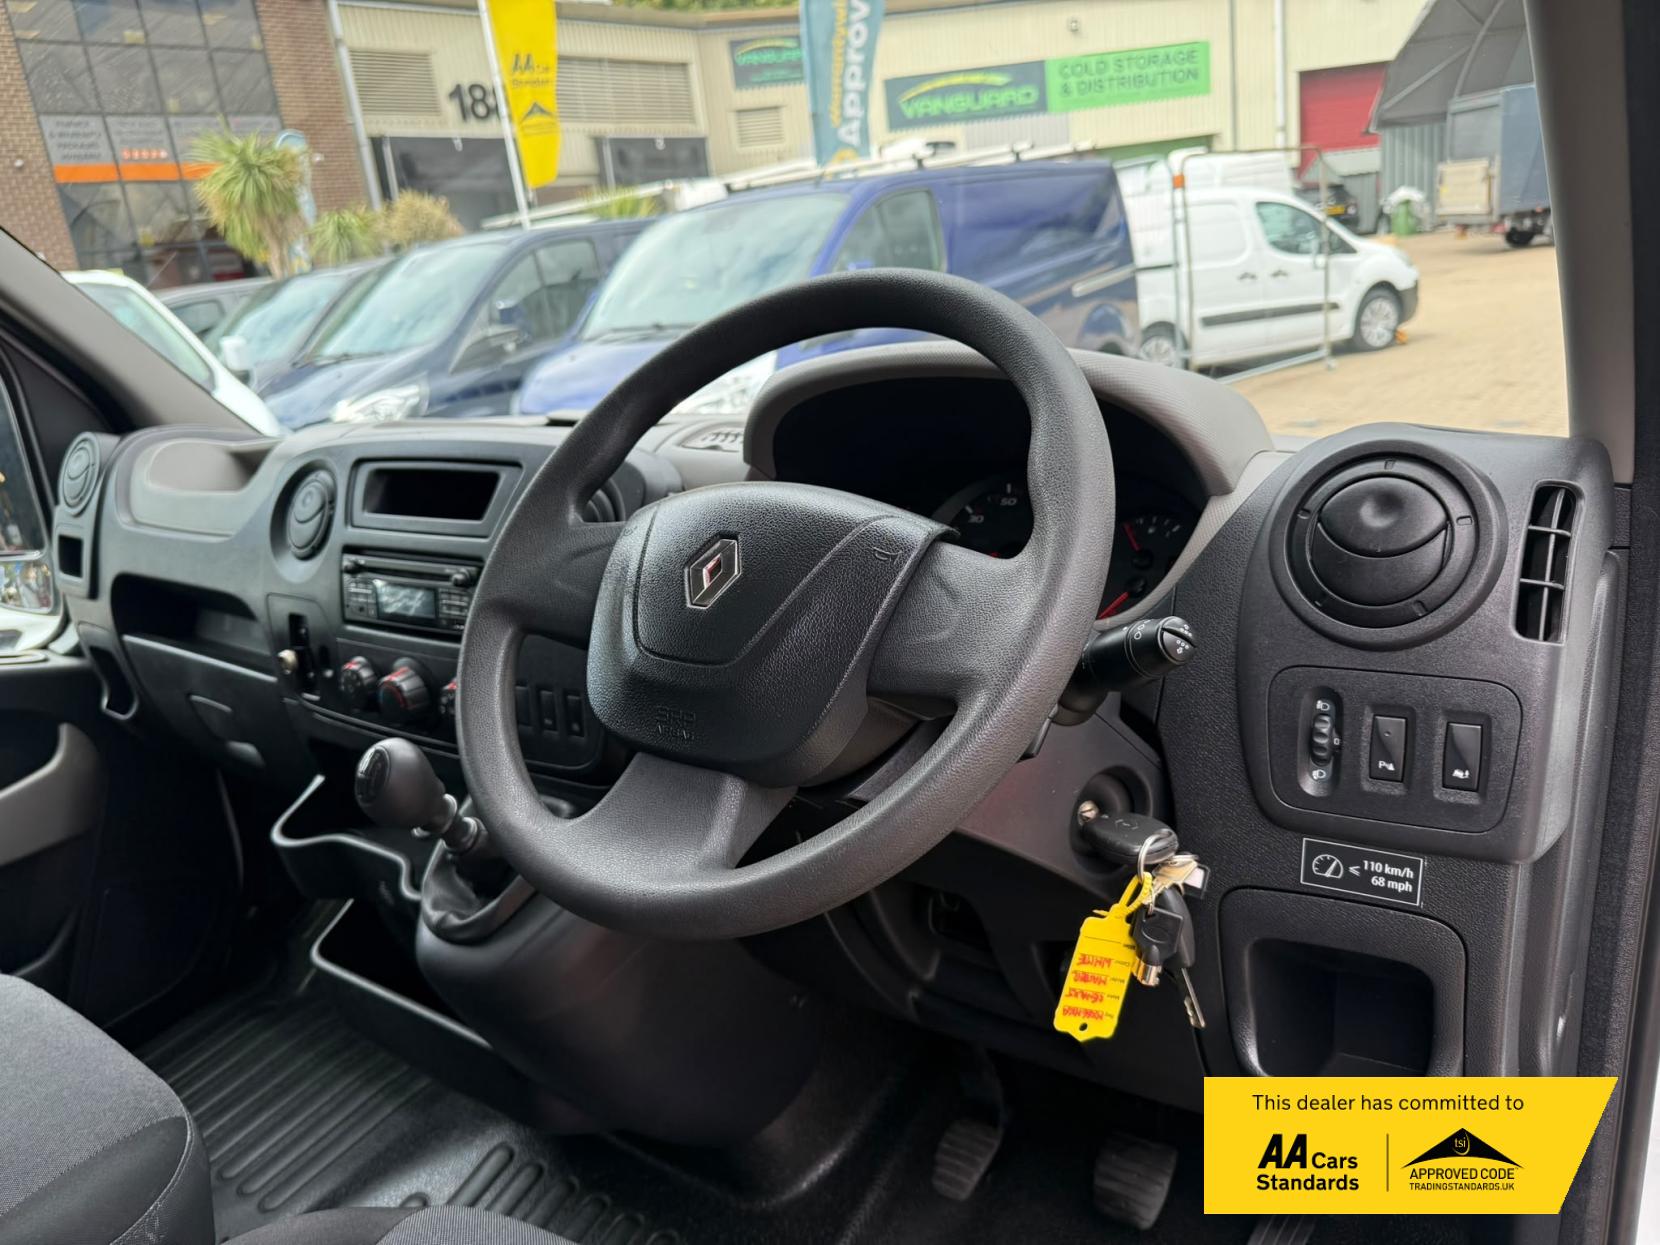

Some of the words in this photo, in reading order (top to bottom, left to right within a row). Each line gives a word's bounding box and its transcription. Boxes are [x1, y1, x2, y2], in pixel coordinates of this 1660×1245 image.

[1058, 59, 1108, 79] COLD
[1115, 49, 1199, 72] STORAGE
[1072, 68, 1199, 97] DISTRIBUTION
[901, 84, 1040, 119] VANGUARD
[1363, 860, 1383, 873] 110
[1384, 863, 1415, 879] km/h
[1371, 876, 1386, 888] 68
[1387, 878, 1413, 893] mph
